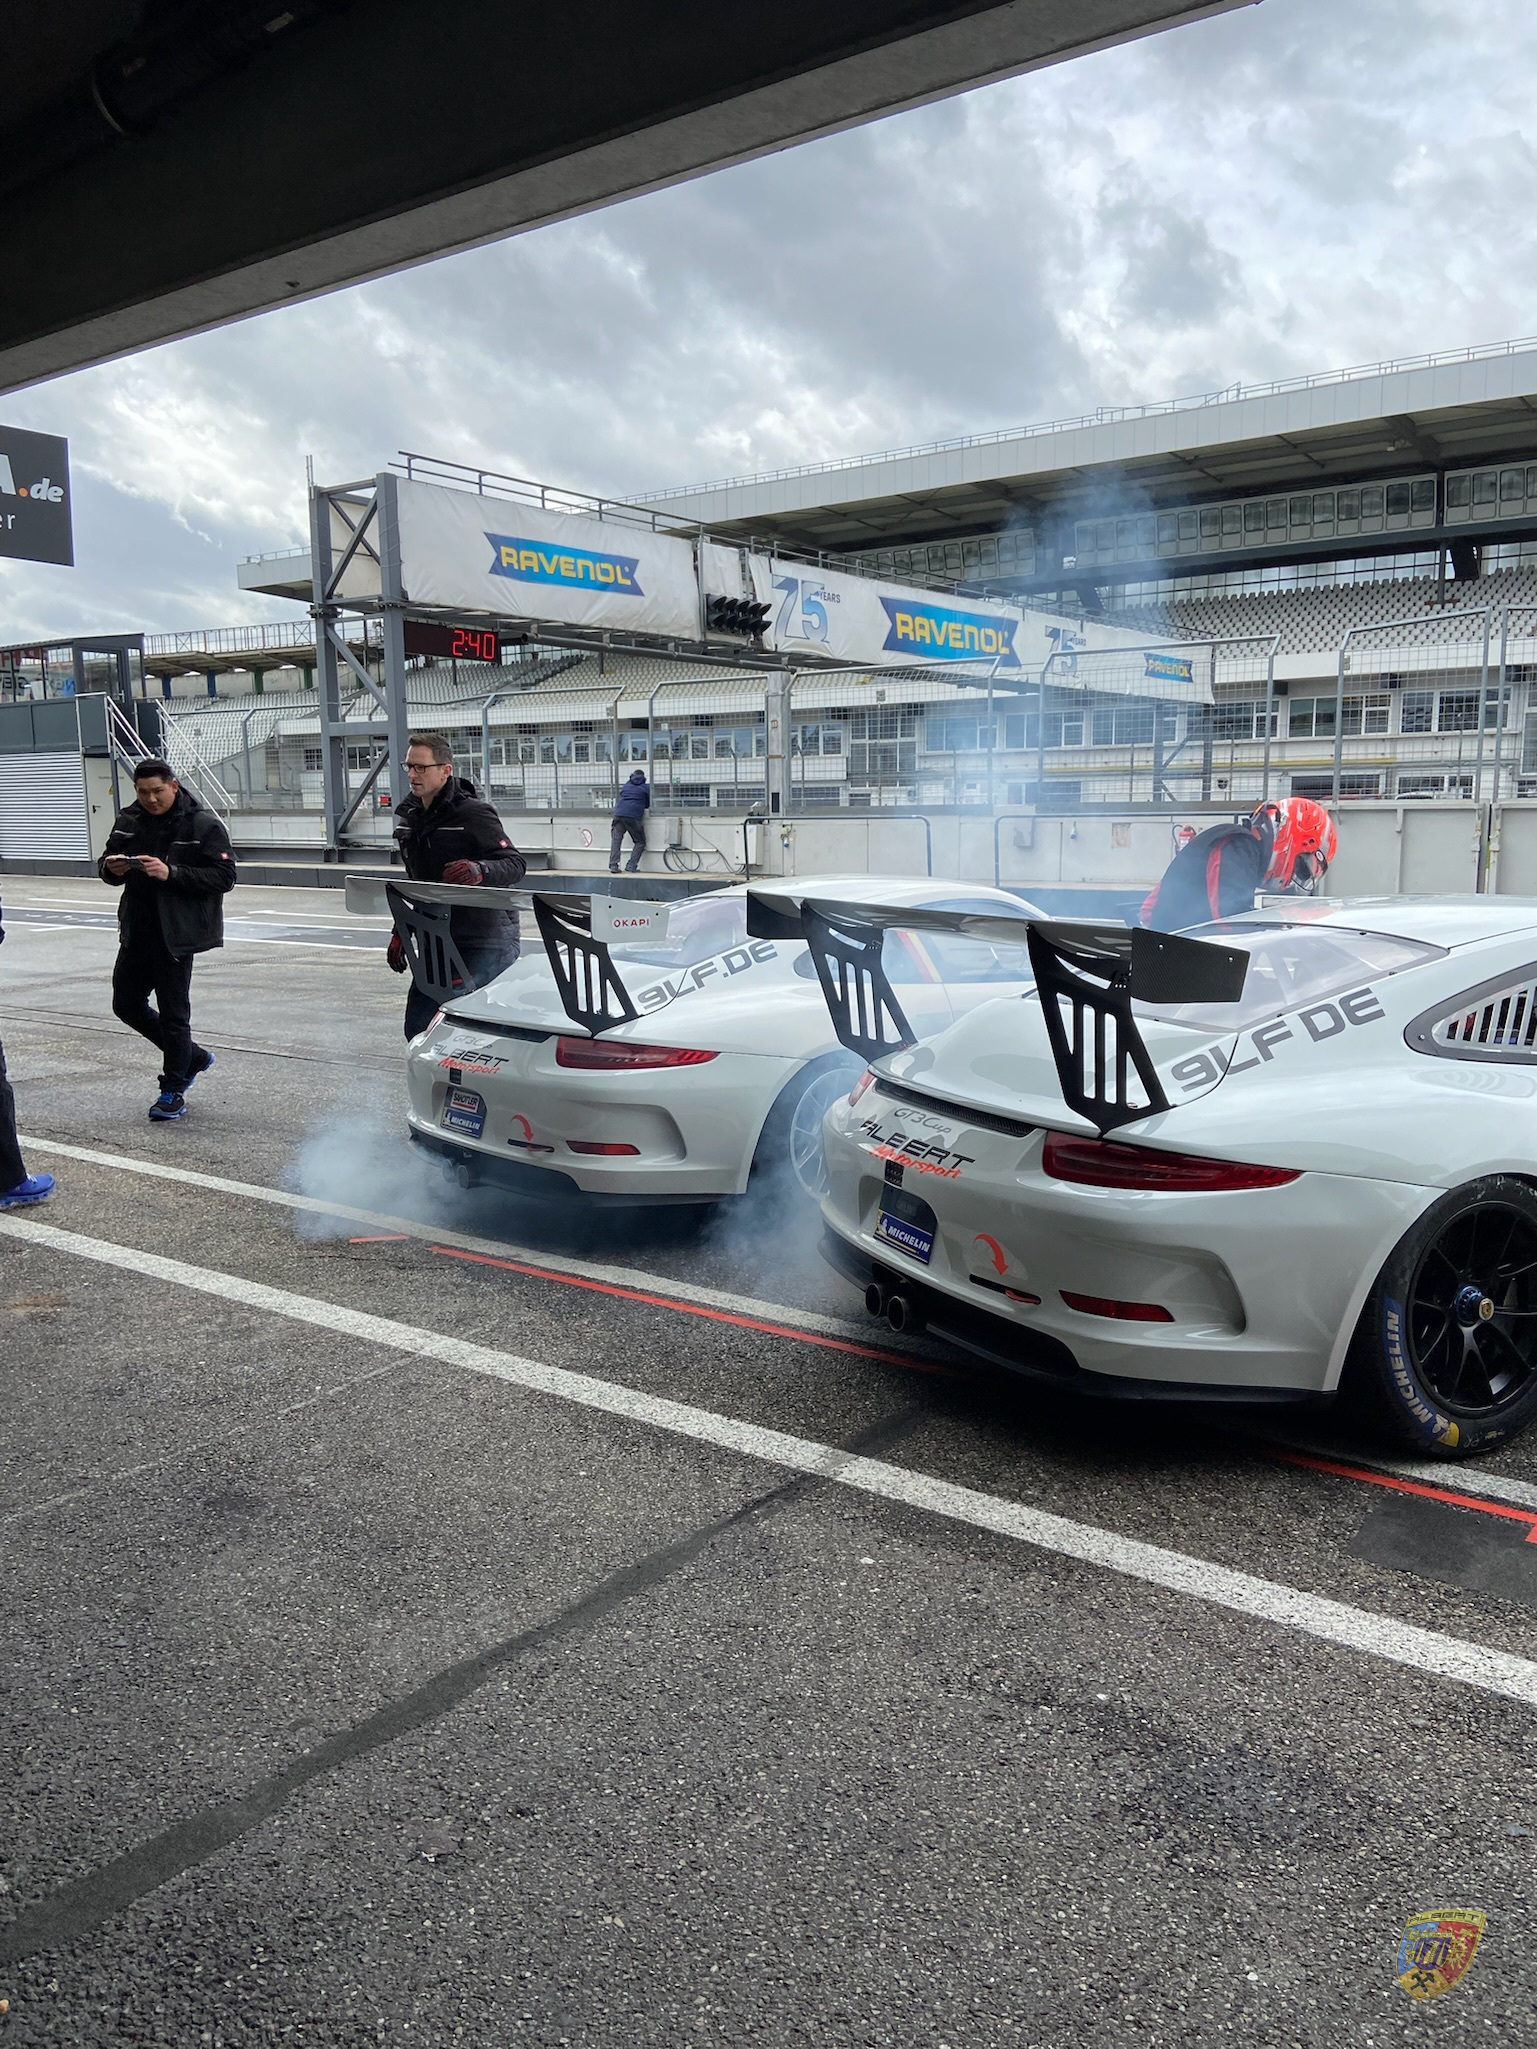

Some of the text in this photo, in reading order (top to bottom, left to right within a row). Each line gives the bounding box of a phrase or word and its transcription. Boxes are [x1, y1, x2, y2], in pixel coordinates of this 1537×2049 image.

[500, 545, 632, 586] RAVENOL
[772, 574, 830, 643] 75
[819, 591, 841, 604] YEARS
[452, 630, 495, 660] 2:40
[895, 612, 1010, 655] RAVENOL
[613, 918, 650, 928] OKAPI
[637, 940, 778, 1010] 9LF.DE
[437, 1057, 501, 1074] Motorsport
[452, 1116, 481, 1131] MICHELIN
[860, 1119, 976, 1170] ALBERT
[868, 1143, 963, 1180] Motorsport
[888, 1225, 931, 1254] MICHELIN
[1386, 1310, 1434, 1425] MICHELIN
